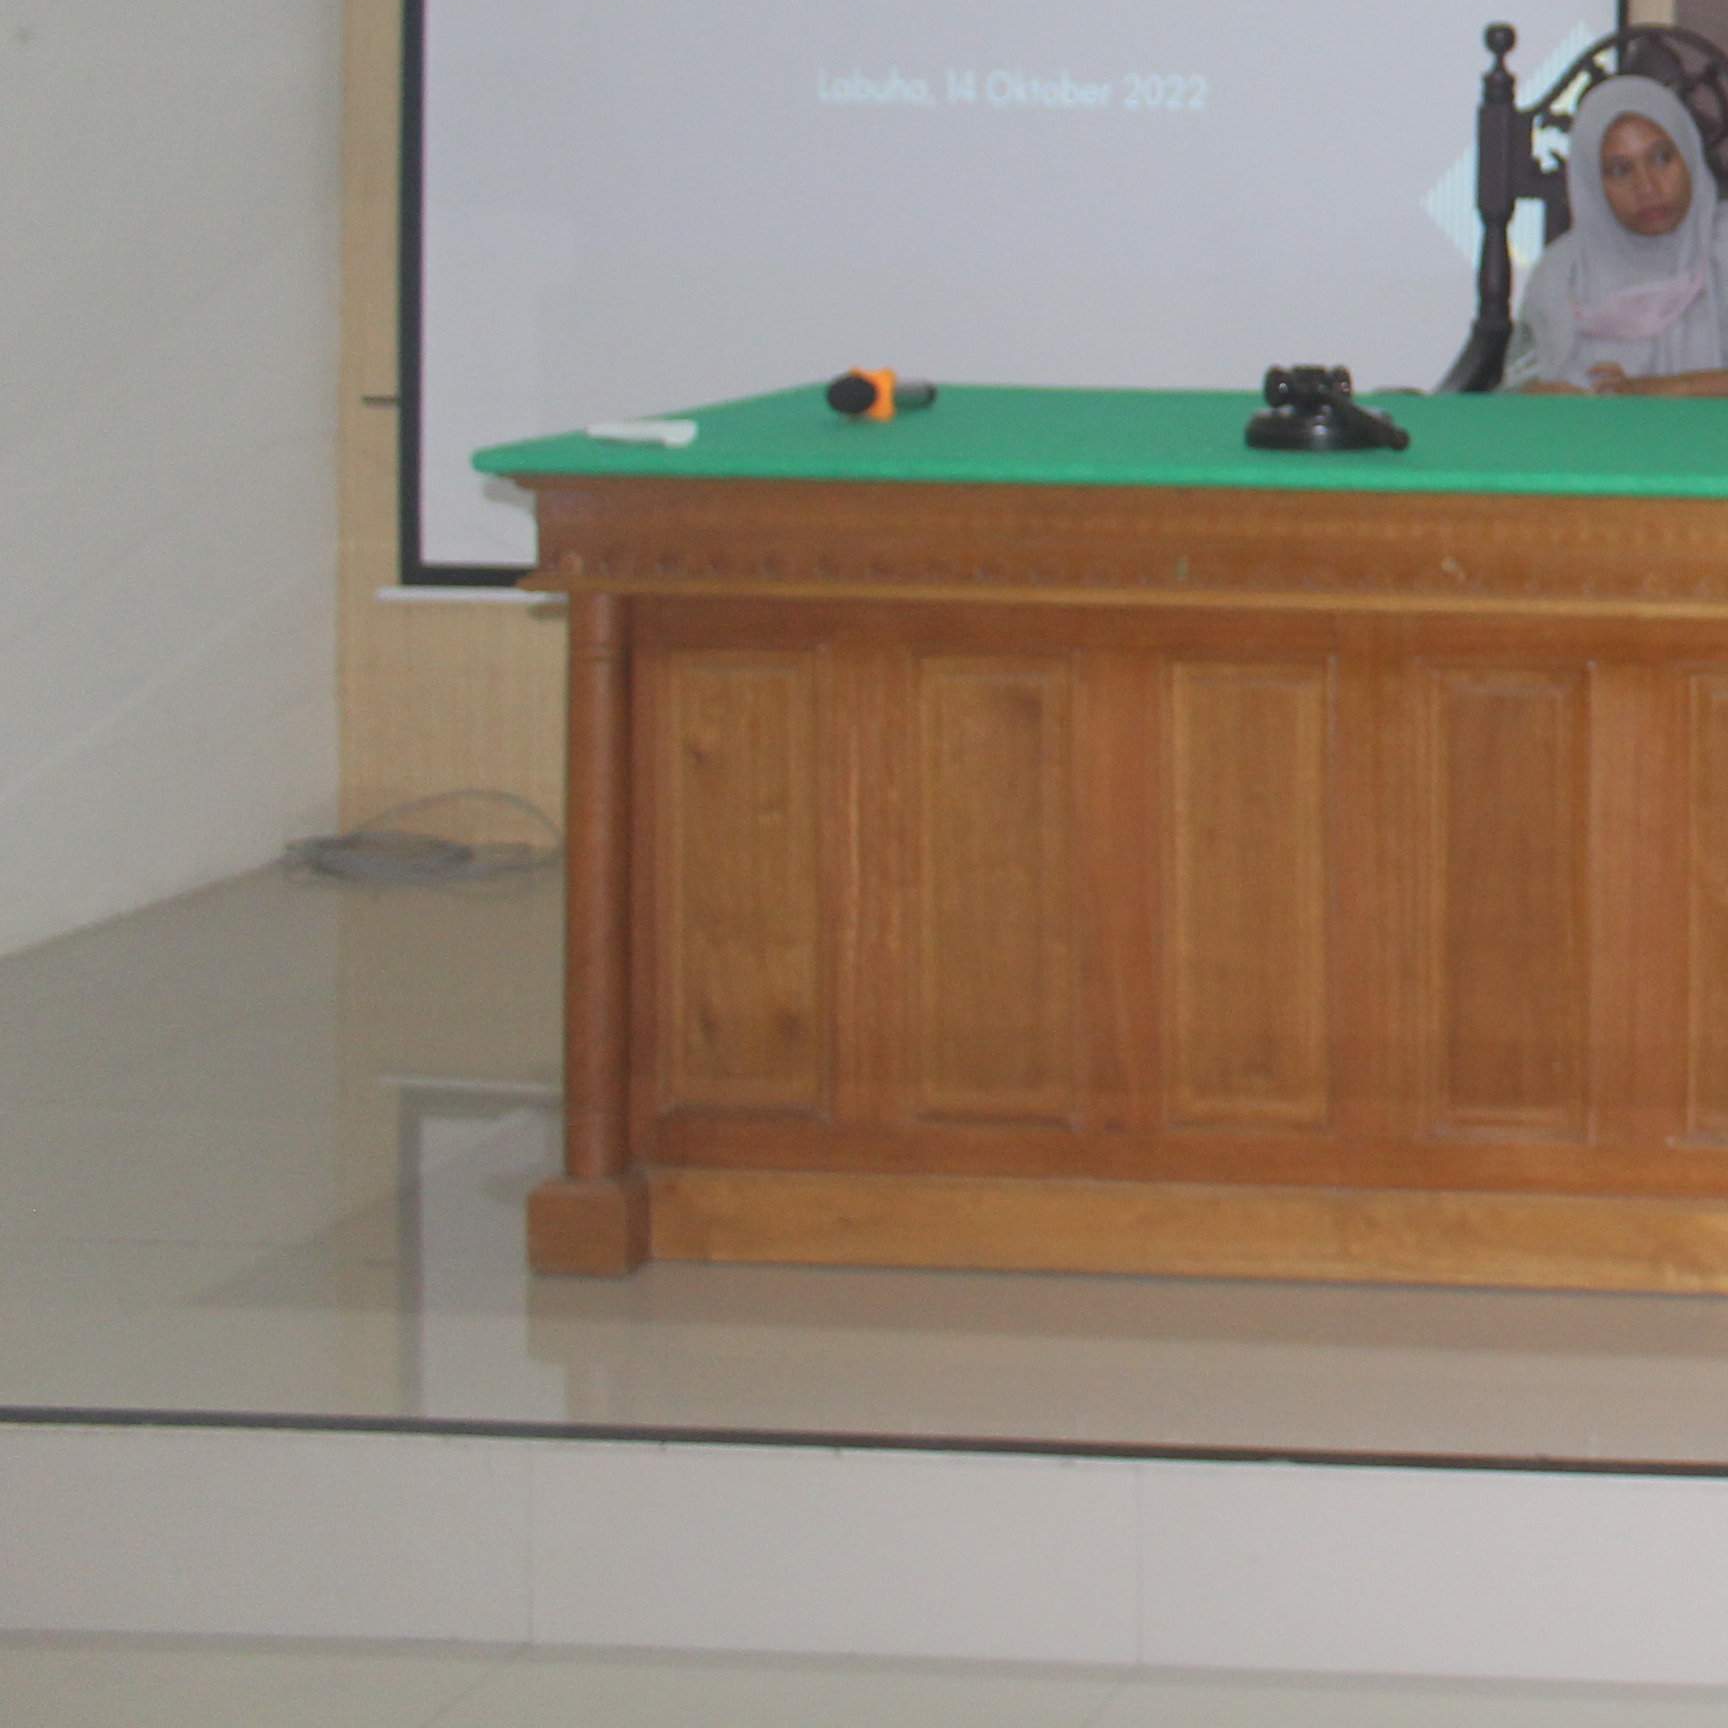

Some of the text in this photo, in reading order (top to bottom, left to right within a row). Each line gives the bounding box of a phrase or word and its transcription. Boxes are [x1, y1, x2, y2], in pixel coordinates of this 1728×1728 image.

[817, 67, 1209, 110] Labuha, 14 Oktober 2022
